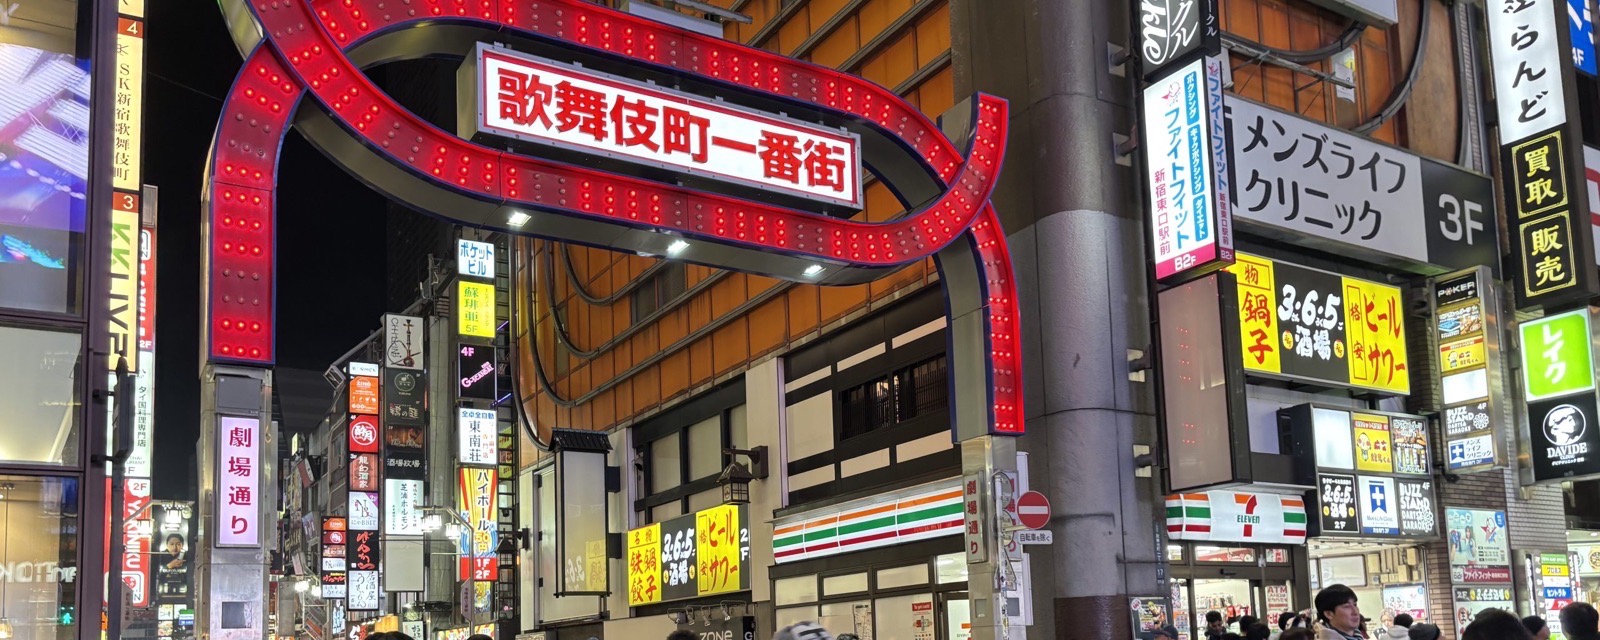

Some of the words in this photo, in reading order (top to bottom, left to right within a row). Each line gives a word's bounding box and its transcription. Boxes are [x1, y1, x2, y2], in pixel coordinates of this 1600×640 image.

[126, 21, 138, 35] 4
[1186, 73, 1197, 120] ボクシング
[497, 66, 846, 194] 歌舞伎町一番街
[1208, 77, 1228, 191] ファイトフィット
[1190, 127, 1204, 194] キックボクシング
[1242, 115, 1406, 194] メンズライフ
[1164, 107, 1189, 250] ファイトフィット
[1524, 144, 1557, 206] 買取
[123, 194, 135, 210] 3
[1154, 169, 1171, 256] 新宿東口駅前
[1196, 199, 1206, 240] ダイエット
[1219, 192, 1230, 247] 新宿東口駅前
[1245, 168, 1382, 241] クリニック
[1437, 193, 1484, 246] 3F
[460, 241, 493, 261] ポケット
[468, 259, 487, 276] ビル
[1173, 255, 1196, 273] B2F
[1221, 248, 1234, 261] B2F
[1530, 223, 1565, 288] 販売
[1244, 264, 1259, 285] 物
[465, 324, 479, 333] 5F
[1350, 302, 1364, 361] 格安
[1363, 293, 1401, 340] ビール
[140, 340, 152, 348] 2F
[461, 346, 475, 357] 4F
[1295, 324, 1331, 361] 酒場
[1542, 323, 1567, 385] レイク
[1368, 343, 1406, 386] サワー
[138, 386, 147, 448] タイ国料理専門店
[462, 410, 495, 421] 全卓全自動
[1447, 412, 1475, 424] STAND
[469, 420, 482, 462] 東南荘
[1546, 442, 1588, 459] DAVIDE
[133, 483, 147, 491] 2F
[228, 426, 252, 535] 劇場通り
[1399, 482, 1422, 498] BUZZ
[1422, 482, 1430, 491] 4F
[477, 470, 490, 531] ハイボール
[966, 479, 979, 555] 劇場通り
[1233, 493, 1258, 537] 7
[1400, 496, 1430, 510] STAND
[634, 527, 653, 545] 名物
[708, 508, 736, 548] ビール
[1020, 533, 1050, 542] 自転車を除く
[1334, 521, 1346, 530] 2F
[476, 557, 490, 568] 1F
[630, 547, 657, 577] 鉄鍋
[699, 528, 708, 577] 格安
[475, 569, 491, 580] 2F
[631, 574, 658, 604] 餃子
[669, 559, 689, 587] 酒場
[709, 554, 738, 592] サワー
[1267, 585, 1288, 593] ATM
